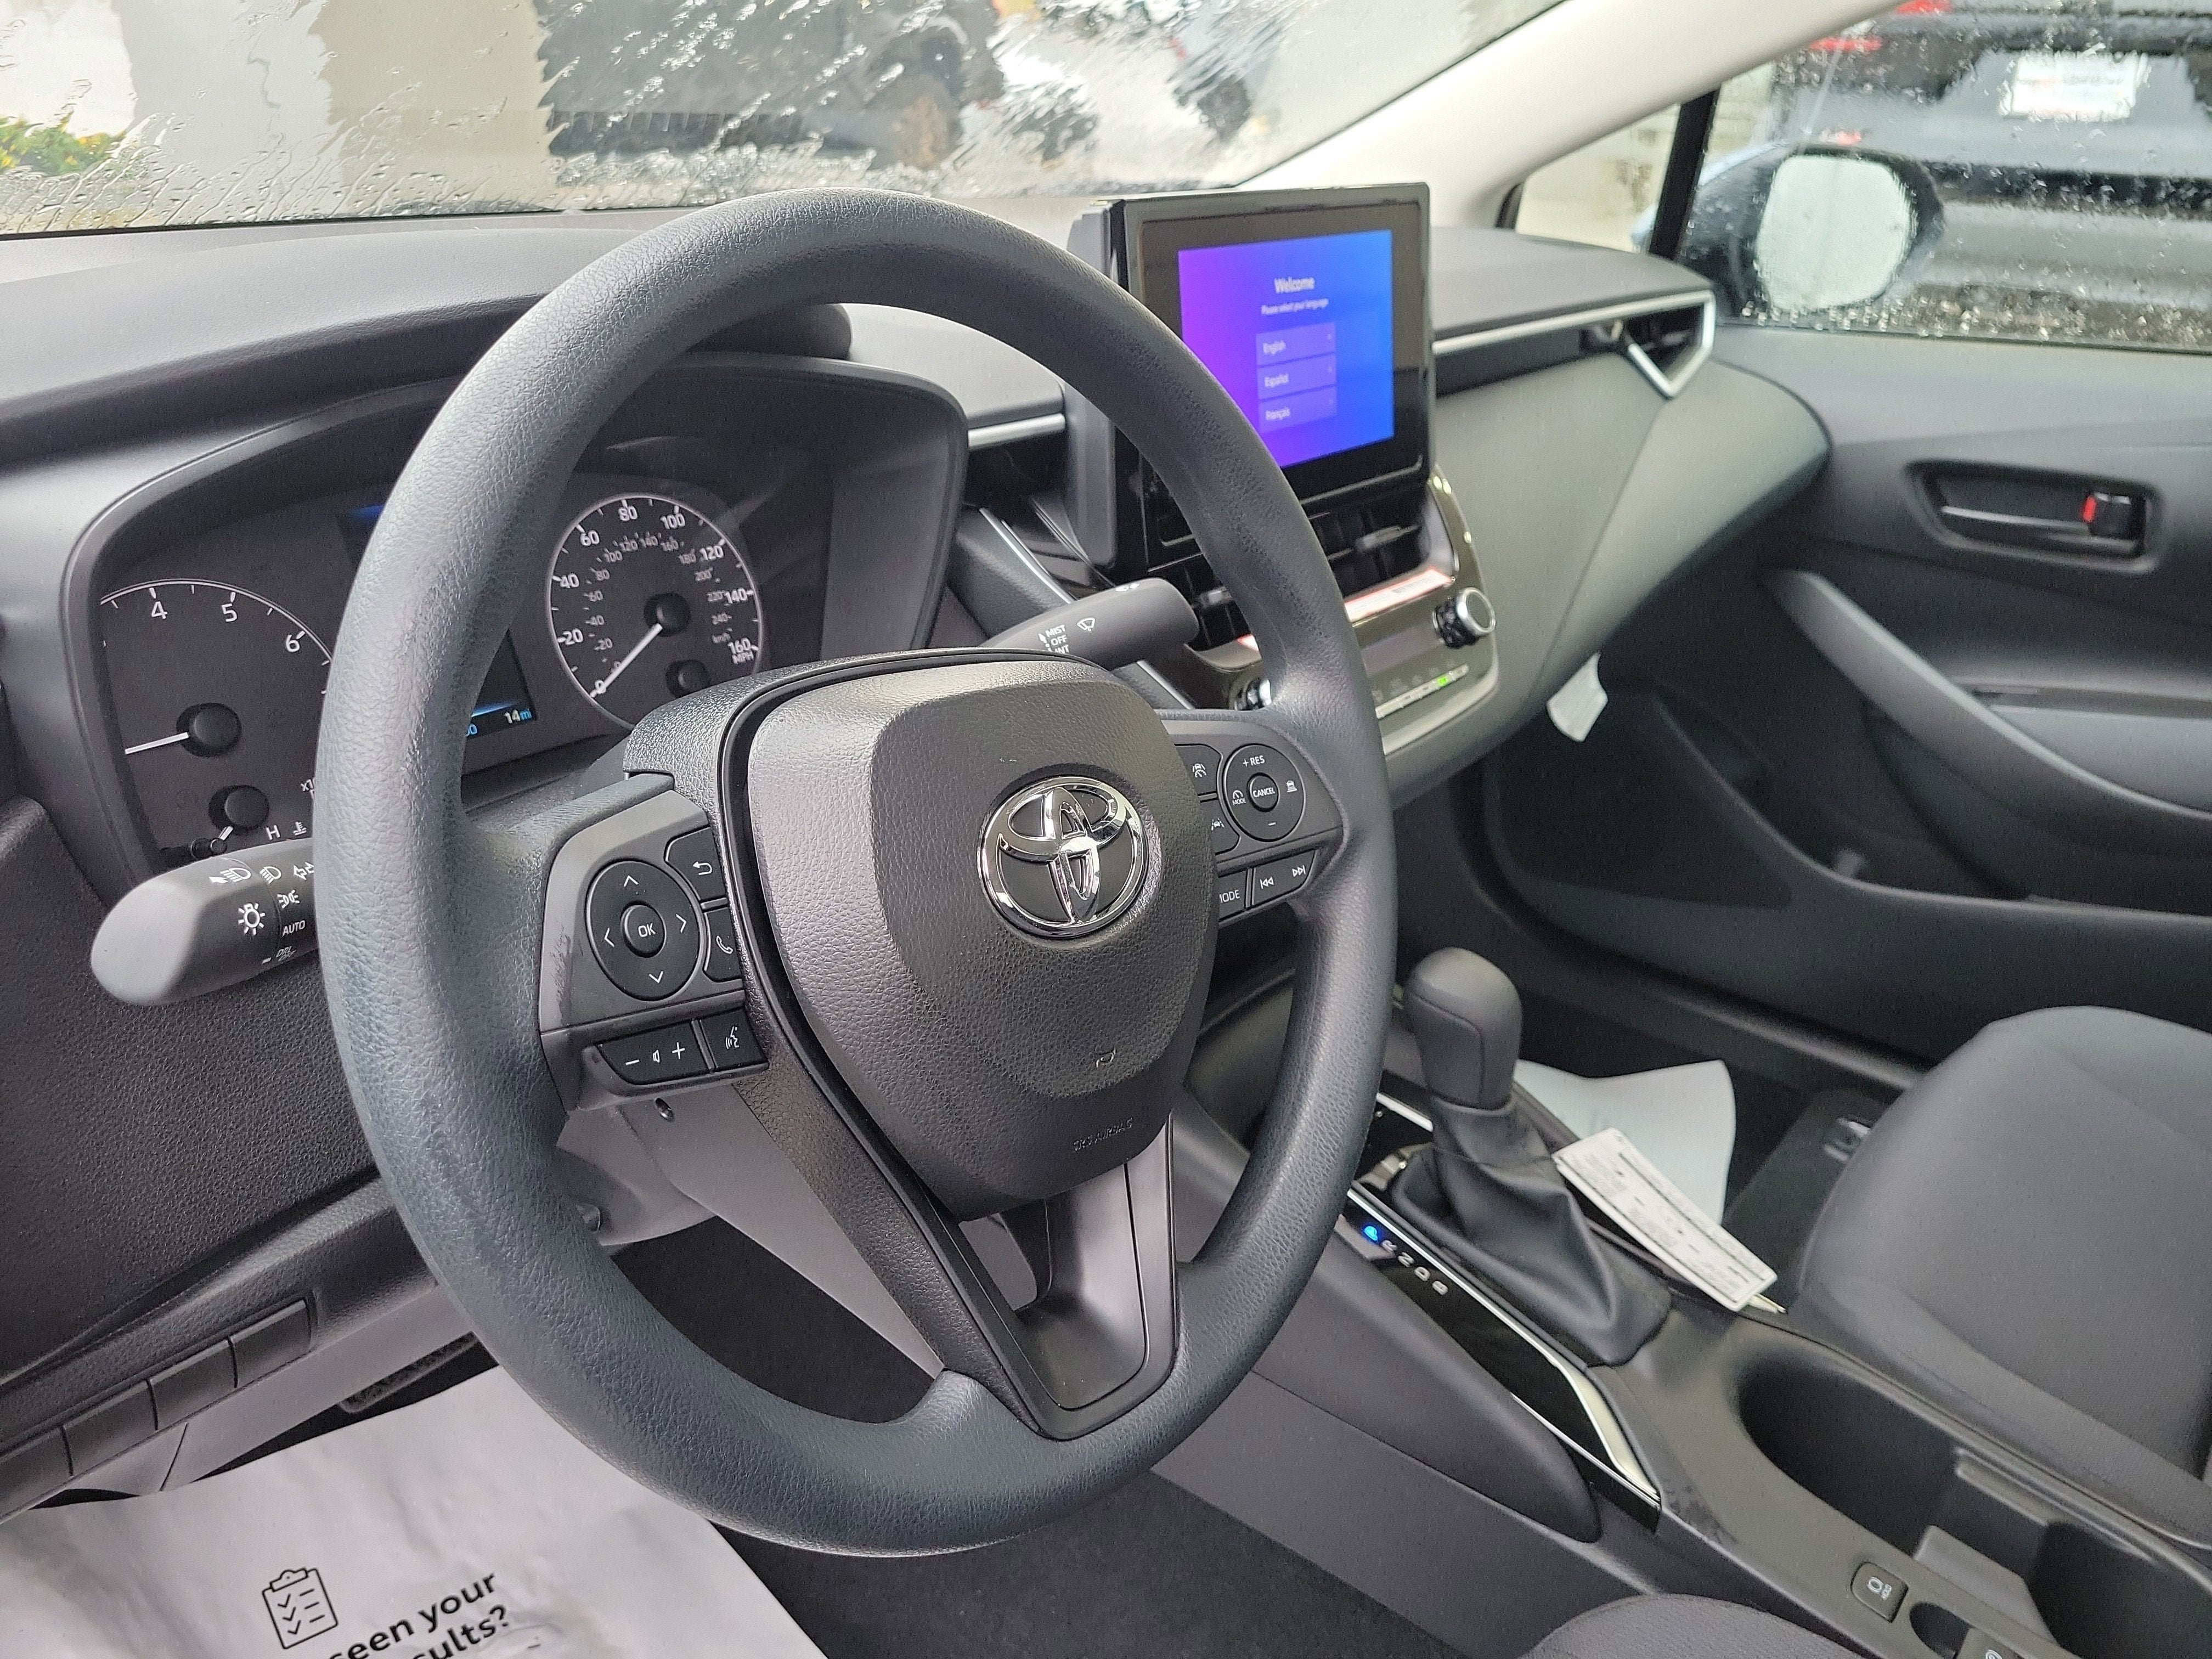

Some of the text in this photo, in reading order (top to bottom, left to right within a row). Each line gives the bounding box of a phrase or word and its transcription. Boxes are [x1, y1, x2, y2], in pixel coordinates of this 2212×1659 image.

[1274, 276, 1316, 294] Welcome
[1263, 340, 1286, 355] English
[618, 506, 637, 521] 80
[661, 513, 685, 529] 100
[580, 530, 600, 546] 60
[605, 550, 623, 562] 100
[699, 545, 724, 560] 120
[560, 573, 579, 588] 40
[595, 569, 610, 580] 80
[589, 591, 603, 602] 60
[724, 587, 748, 603] 140
[151, 601, 168, 619] 4
[222, 603, 238, 622] 5
[590, 615, 605, 626] 40
[563, 629, 583, 646] 20
[1045, 624, 1065, 637] MIST
[285, 634, 301, 652] 6
[728, 637, 751, 654] 160
[1051, 635, 1067, 646] OFF
[1054, 644, 1069, 654] INT
[732, 650, 754, 664] MPH
[1250, 755, 1265, 766] RES
[1252, 787, 1276, 798] CANCEL
[1232, 798, 1246, 806] MODE
[267, 825, 280, 840] H
[281, 920, 306, 937] AUTO
[638, 923, 656, 937] OK
[275, 945, 292, 958] DRL
[1381, 1240, 1397, 1253] R
[418, 1573, 495, 1633] your
